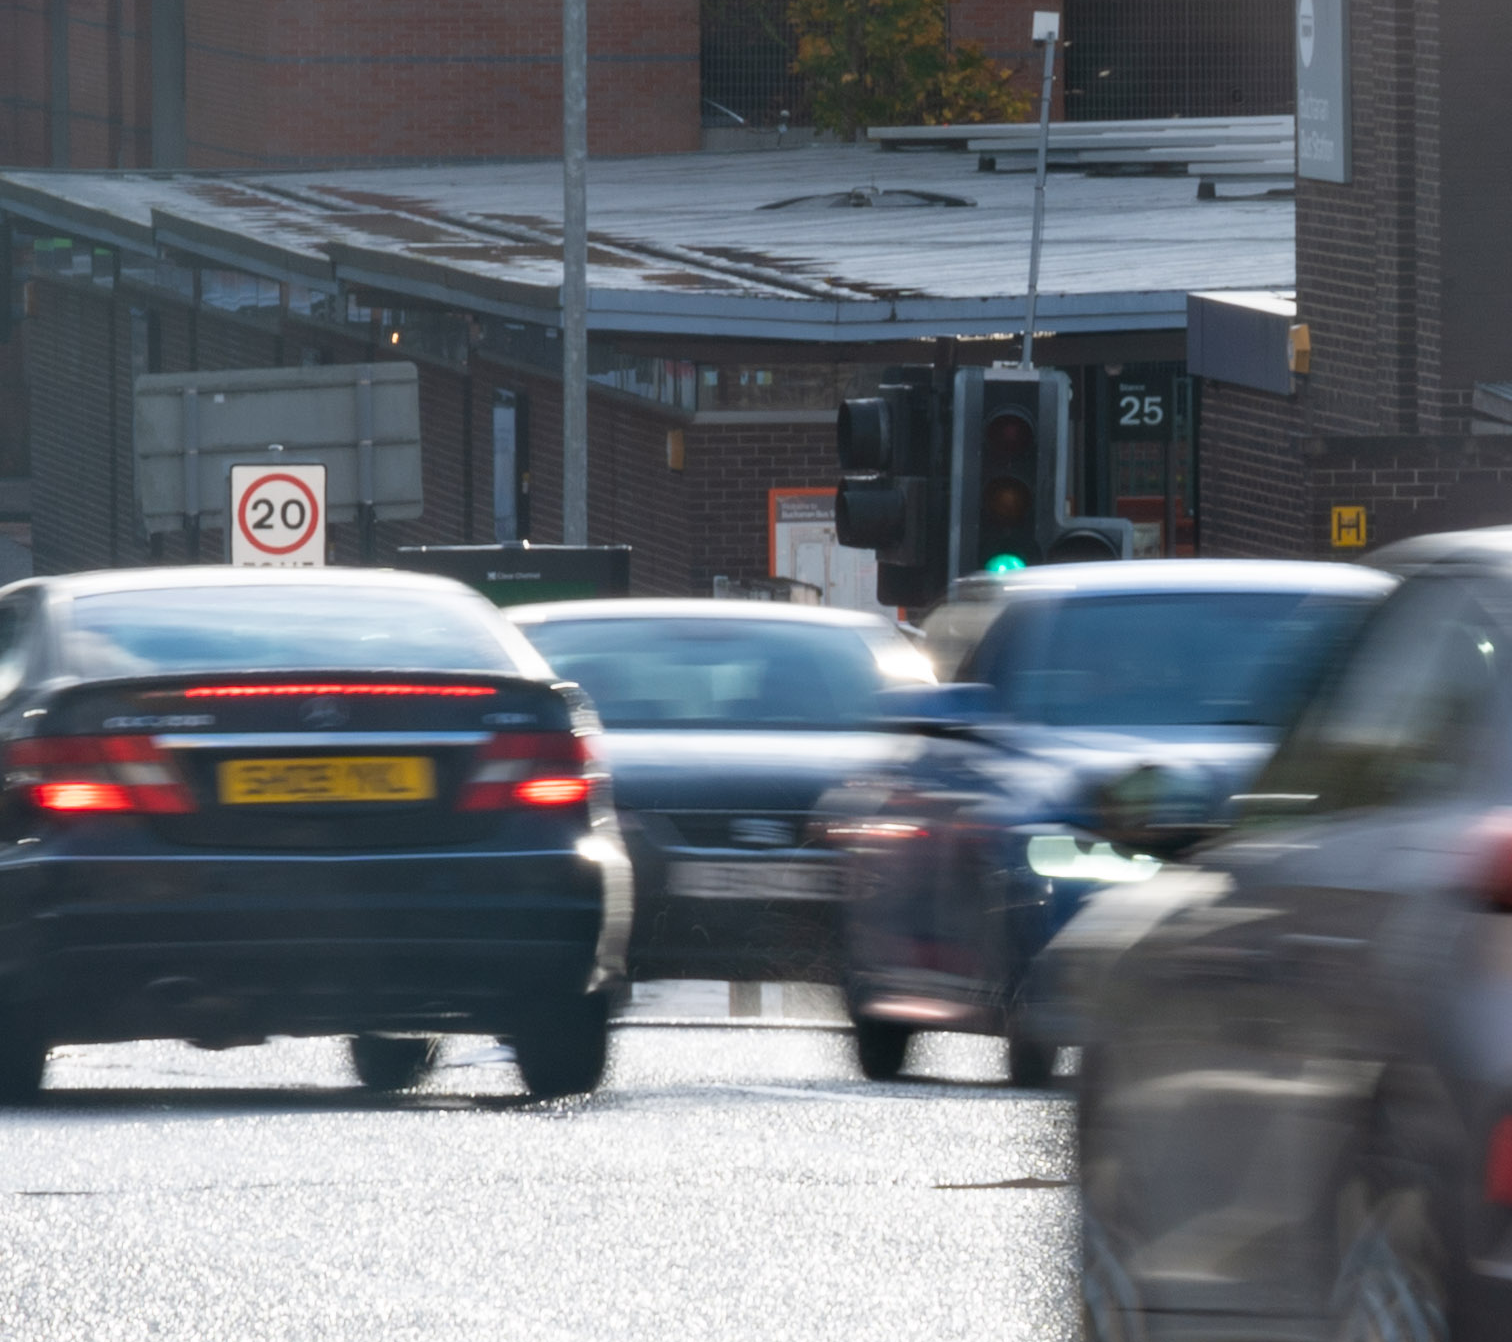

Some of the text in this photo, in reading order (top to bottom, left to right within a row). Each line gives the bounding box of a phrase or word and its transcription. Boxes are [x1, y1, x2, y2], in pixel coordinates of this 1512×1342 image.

[1119, 396, 1163, 425] 25
[251, 498, 306, 530] 20
[1338, 511, 1360, 541] H
